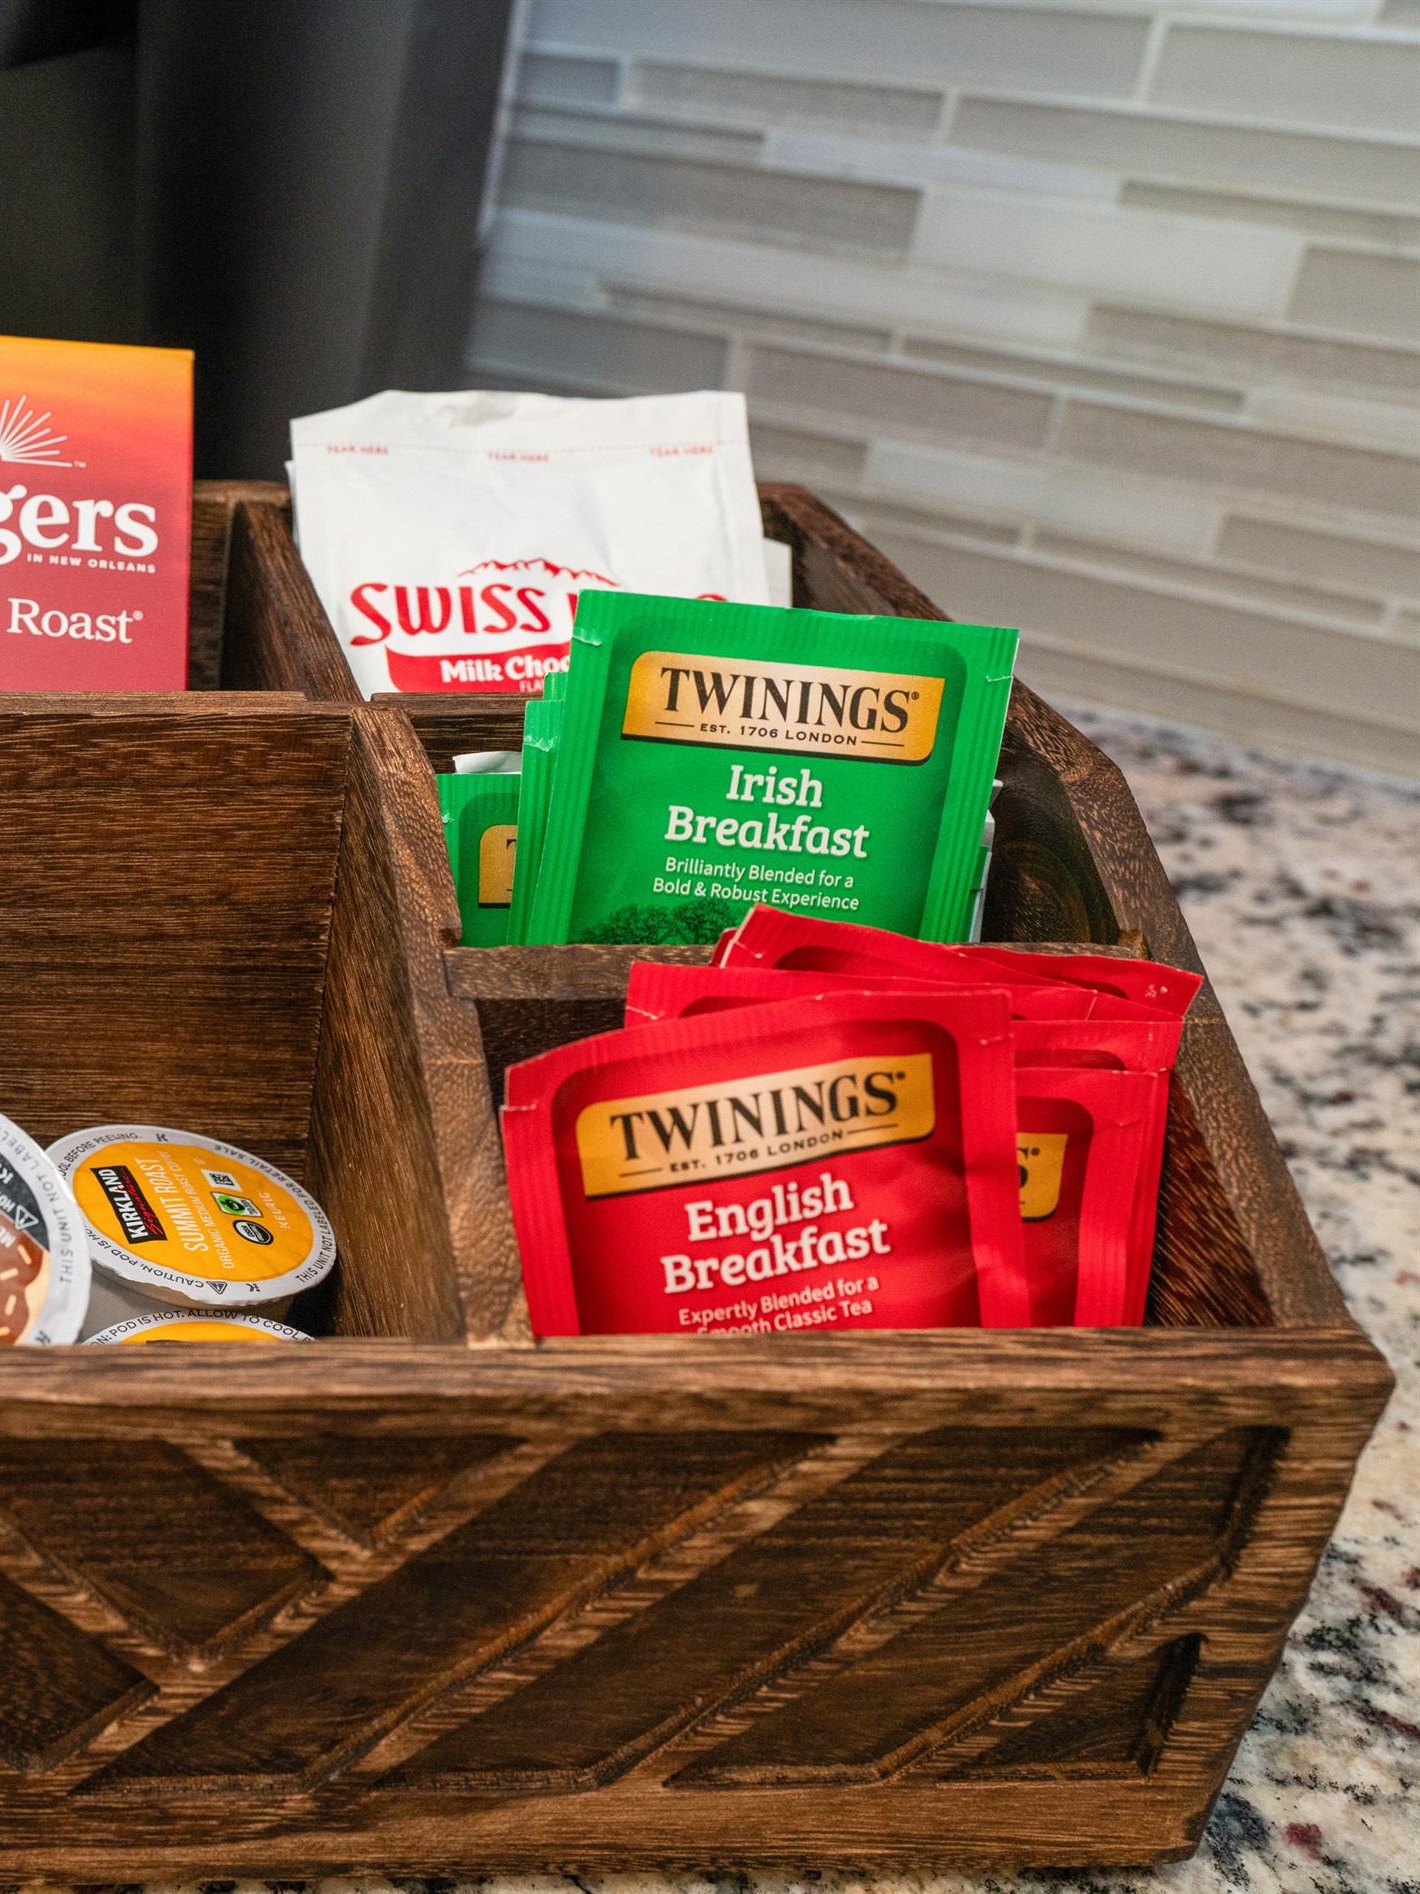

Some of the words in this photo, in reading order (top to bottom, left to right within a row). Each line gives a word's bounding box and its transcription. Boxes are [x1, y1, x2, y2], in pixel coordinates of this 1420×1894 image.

[27, 553, 43, 563] IN
[49, 554, 82, 567] NEW
[87, 558, 157, 574] ORLEANS
[350, 582, 551, 647] SWISS
[440, 658, 504, 684] Milk
[700, 722, 731, 734] EST.
[740, 725, 779, 739] 1706
[785, 729, 858, 747] LONDON
[726, 764, 823, 808] Irish
[664, 805, 870, 858] Breakfast
[665, 856, 746, 882] Brilliantly
[748, 864, 816, 886] Blended
[818, 869, 843, 887] for
[844, 876, 855, 888] a
[652, 877, 691, 895] Bold
[694, 881, 707, 897] &
[710, 883, 768, 903] Robust
[771, 888, 860, 911] Experience
[64, 1140, 97, 1163] BEFORE
[669, 1158, 707, 1173] EST.
[715, 1149, 760, 1166] 1706
[767, 1129, 845, 1157] LONDON
[35, 1166, 60, 1204] NOT
[135, 1158, 180, 1194] ROAST
[173, 1173, 197, 1195] ROAST
[250, 1159, 287, 1182] RETAIL
[98, 1168, 149, 1239] KIRKLAND
[286, 1181, 308, 1199] FOR
[189, 1195, 216, 1227] MEDIUM
[304, 1199, 332, 1236] LABELED
[685, 1172, 855, 1242] English
[54, 1207, 72, 1245] UNIT
[159, 1197, 209, 1253] SUMMIT
[98, 1240, 112, 1251] IS
[110, 1248, 139, 1266] POD
[207, 1228, 235, 1269] ORGANIC
[321, 1237, 333, 1252] NOT
[661, 1219, 892, 1294] Breakfast
[59, 1248, 74, 1284] THIS
[142, 1262, 205, 1288] CAUTION:
[295, 1267, 319, 1283] THIS
[313, 1252, 331, 1270] UNIT
[679, 1300, 758, 1326] Expertly
[760, 1281, 836, 1313] Blended
[837, 1278, 865, 1297] for
[867, 1276, 879, 1291] a
[774, 1305, 838, 1331] Classic
[839, 1299, 874, 1318] Tea
[111, 1320, 138, 1337] POD
[140, 1315, 151, 1325] IS
[187, 1309, 238, 1319] ALLOW
[242, 1314, 261, 1325] TO
[263, 1319, 298, 1340] COOL
